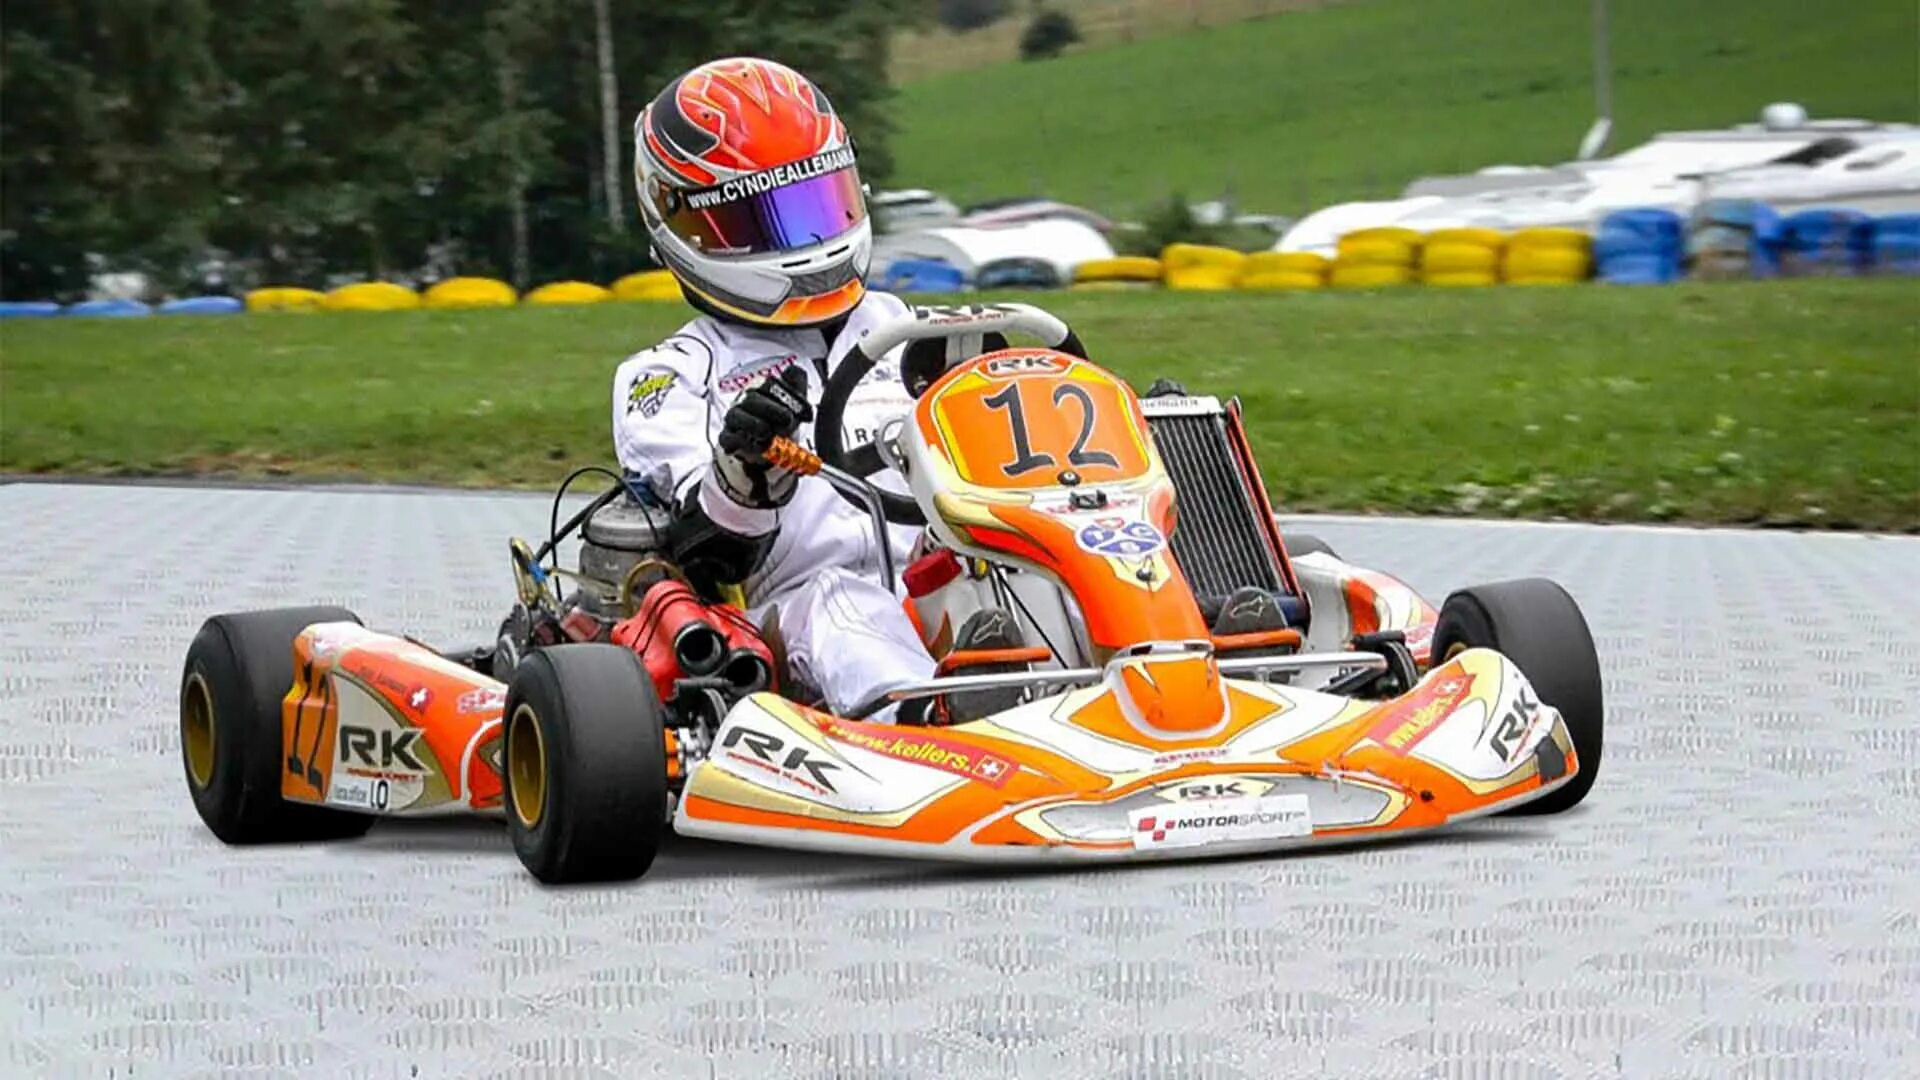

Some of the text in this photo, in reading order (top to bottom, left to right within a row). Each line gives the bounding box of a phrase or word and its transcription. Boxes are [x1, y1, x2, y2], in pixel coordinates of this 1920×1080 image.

[989, 356, 1053, 372] RK
[984, 383, 1120, 477] 12
[340, 726, 428, 773] RK
[1490, 687, 1538, 762] RK
[722, 726, 842, 795] RK
[1179, 782, 1248, 798] RK
